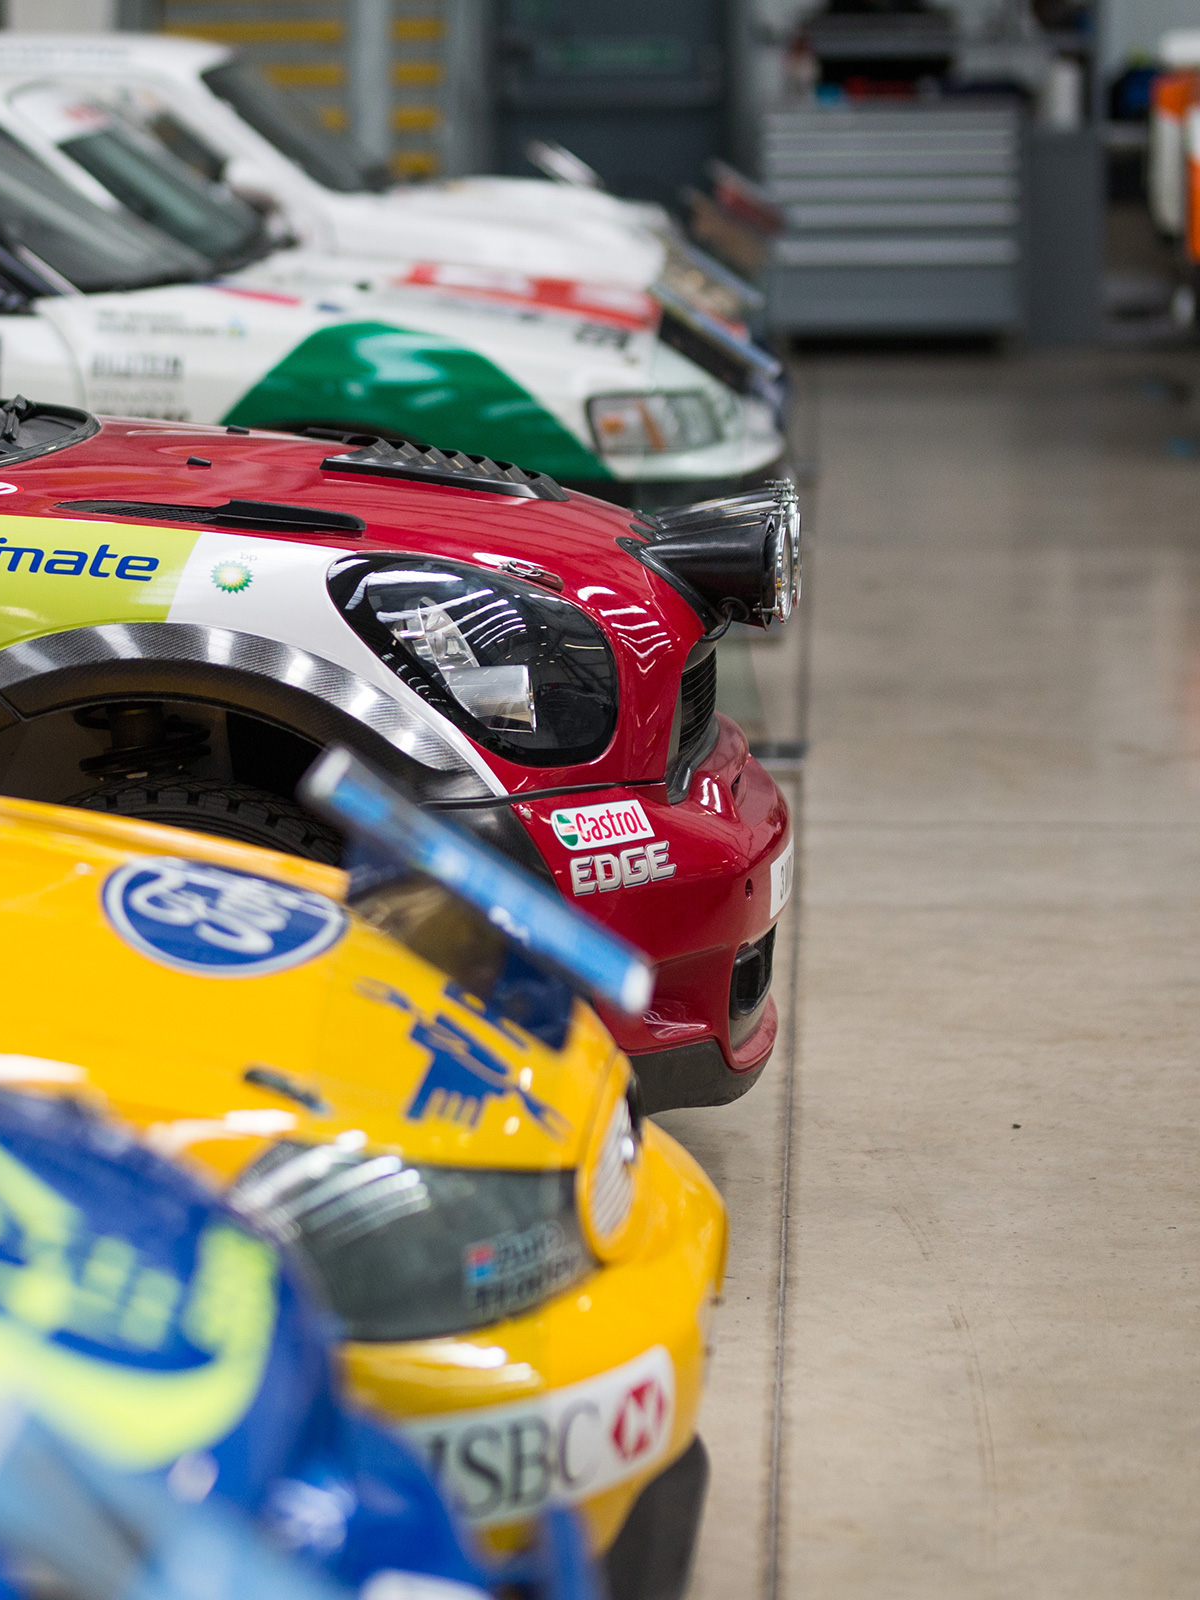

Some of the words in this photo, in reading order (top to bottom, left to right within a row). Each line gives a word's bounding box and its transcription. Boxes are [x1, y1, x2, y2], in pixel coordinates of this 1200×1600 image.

[240, 552, 258, 563] bp
[575, 805, 648, 843] Castrol
[570, 840, 677, 897] EDGE
